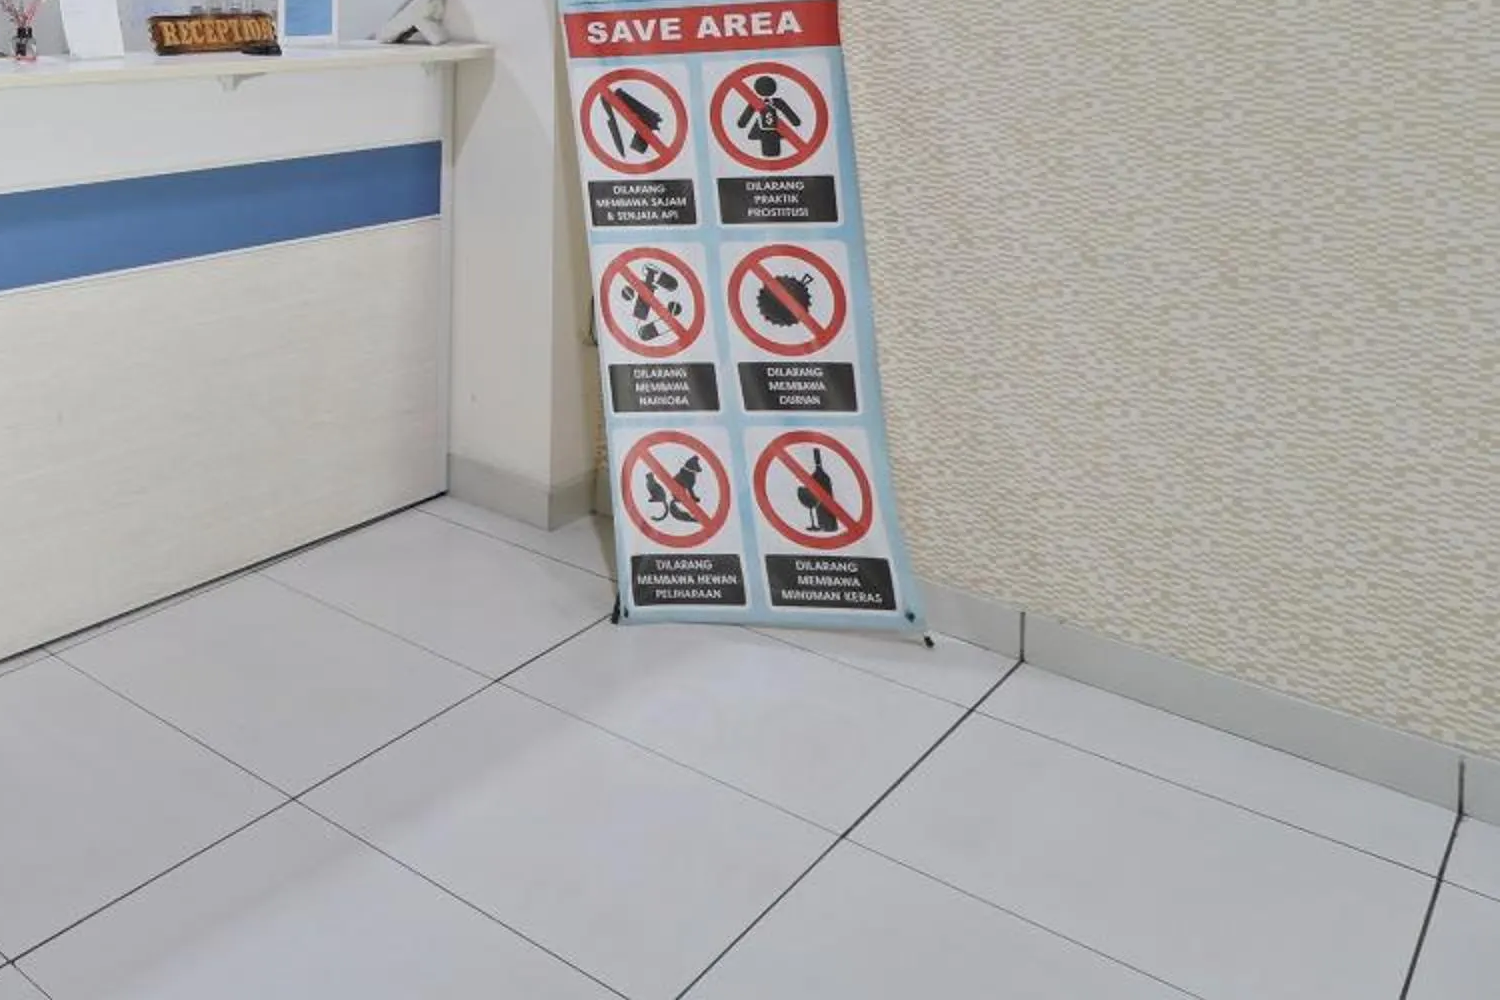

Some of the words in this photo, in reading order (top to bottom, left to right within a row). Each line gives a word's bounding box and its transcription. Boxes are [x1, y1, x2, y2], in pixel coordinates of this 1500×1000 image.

[162, 17, 273, 47] RECEPTION
[586, 17, 683, 45] SAVE
[696, 10, 804, 40] AREA
[612, 184, 667, 195] DILARANG
[745, 180, 805, 191] DILARANG
[595, 198, 649, 208] MEMBAWA
[651, 196, 688, 207] SAJAM
[752, 193, 800, 203] PRAKTIK
[617, 211, 659, 221] SENJATA
[661, 209, 680, 219] API
[747, 207, 809, 218] PROSTITUSI
[633, 367, 688, 378] DILARANG
[767, 366, 825, 378] DILARANG
[635, 381, 690, 392] MEMBAWA
[768, 381, 827, 392] MEMBAWA
[779, 395, 821, 406] DURIAN
[655, 559, 713, 571] DILARANG
[795, 560, 859, 573] DILARANG
[637, 574, 695, 585] MEMBAWA
[697, 573, 738, 585] HEWAN
[797, 574, 861, 587] MEMBAWA
[655, 589, 722, 600] PELIHARAAN
[781, 589, 841, 601] MINUMAN
[843, 591, 884, 604] KERAS
